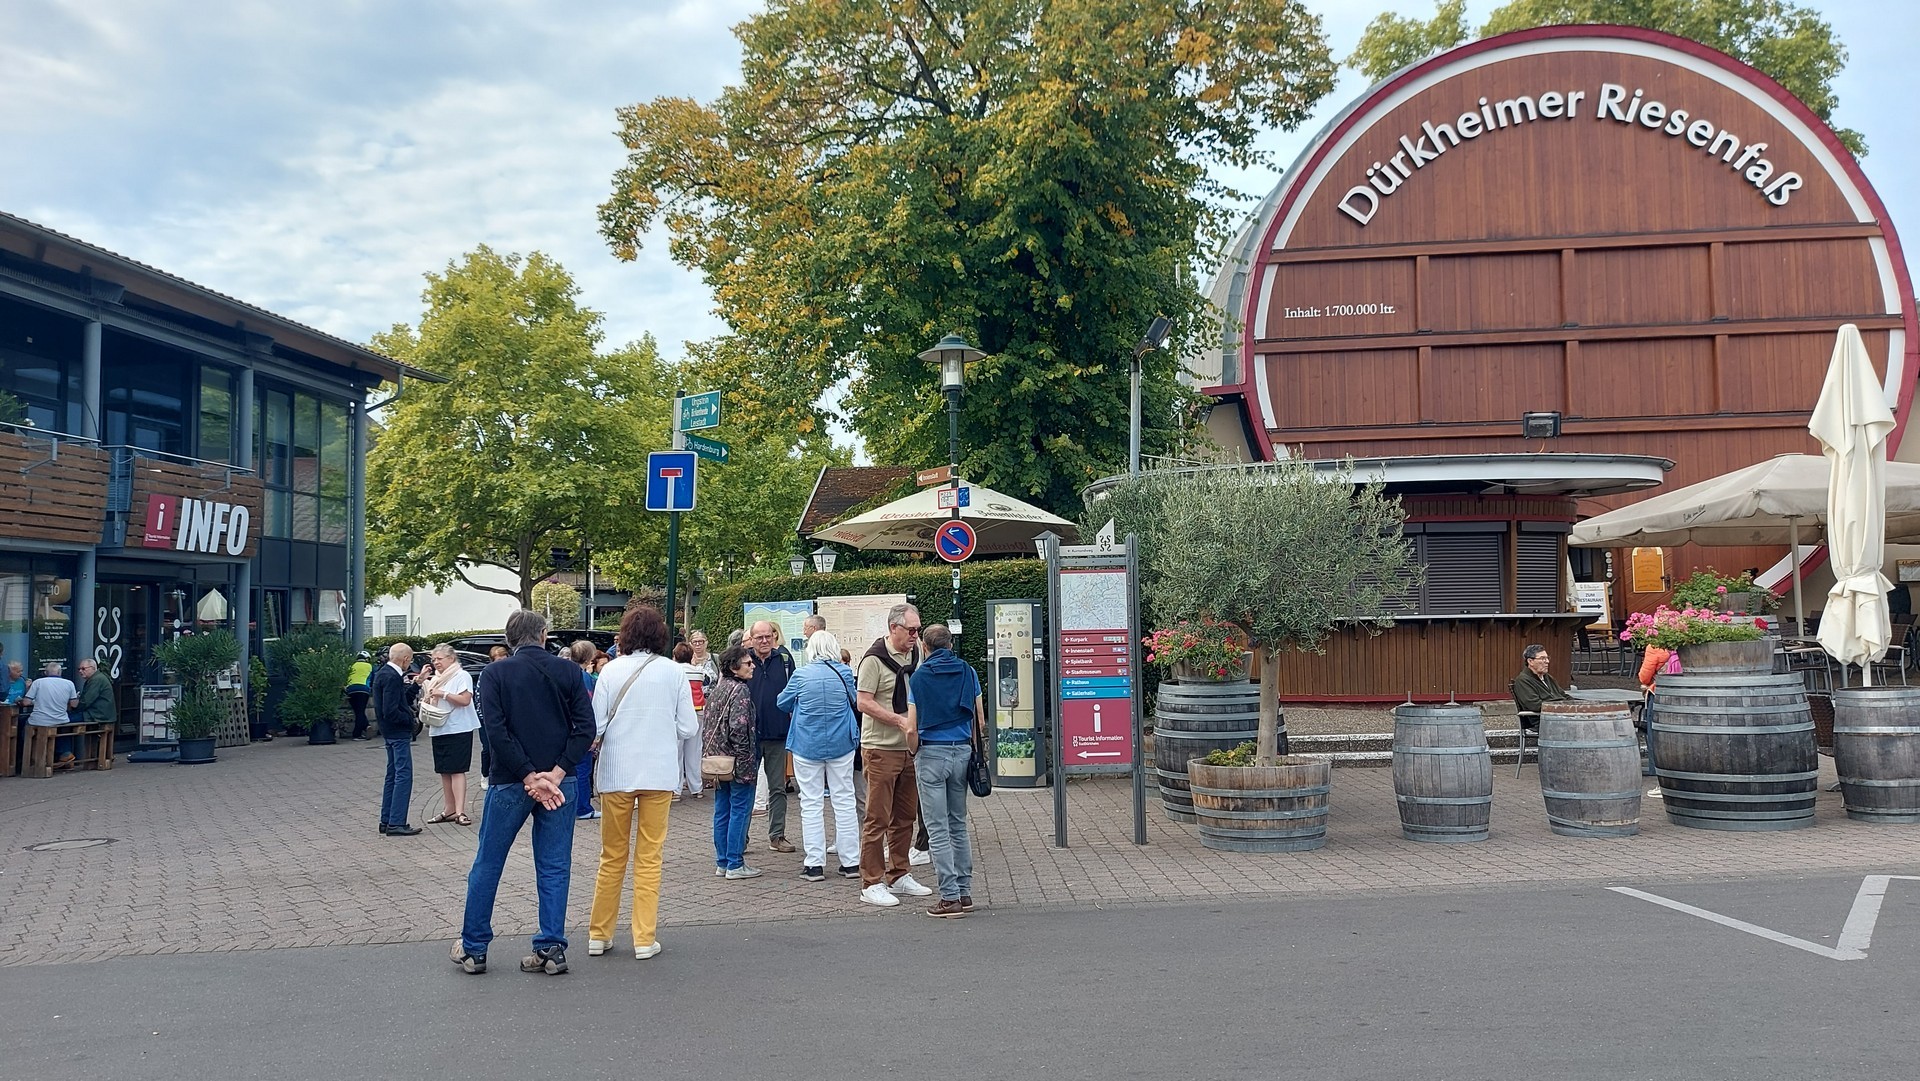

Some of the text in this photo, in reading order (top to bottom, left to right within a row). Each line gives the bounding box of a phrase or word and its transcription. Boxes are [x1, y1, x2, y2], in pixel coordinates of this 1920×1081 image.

[1337, 82, 1804, 226] Dürkheimer Riesenfaß
[1284, 306, 1321, 318] Inhalt:
[1325, 303, 1377, 317] 1.700.000
[693, 441, 720, 457] Hardenburg
[880, 511, 938, 520] Weissbier
[176, 497, 250, 556] INFO
[50, 585, 60, 596] 10
